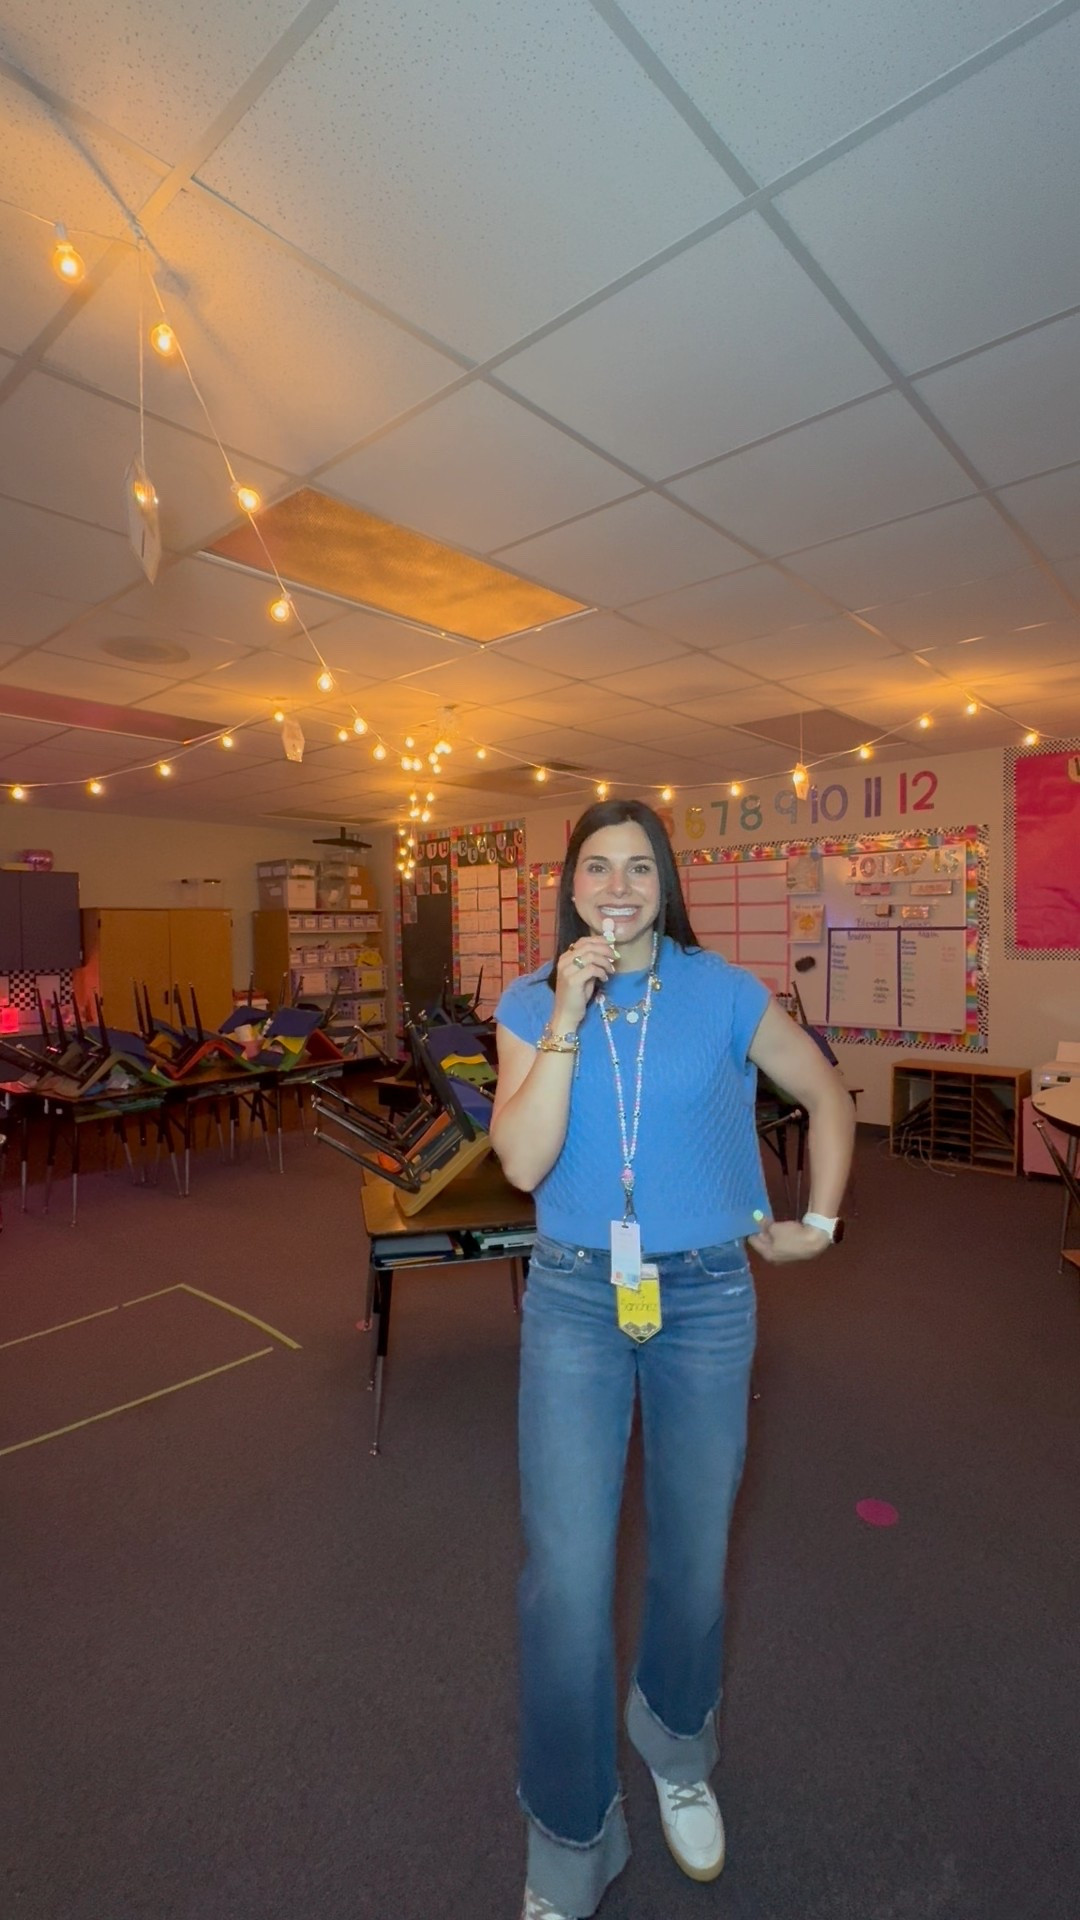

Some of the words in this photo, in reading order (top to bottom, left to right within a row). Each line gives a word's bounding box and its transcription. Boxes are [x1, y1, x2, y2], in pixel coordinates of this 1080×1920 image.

[685, 805, 706, 840] 6
[711, 801, 729, 836] 7
[740, 795, 763, 831] 8
[774, 790, 798, 825] 9
[810, 784, 849, 825] 10
[865, 777, 882, 818] 11
[899, 770, 938, 815] 12
[460, 832, 523, 861] READING
